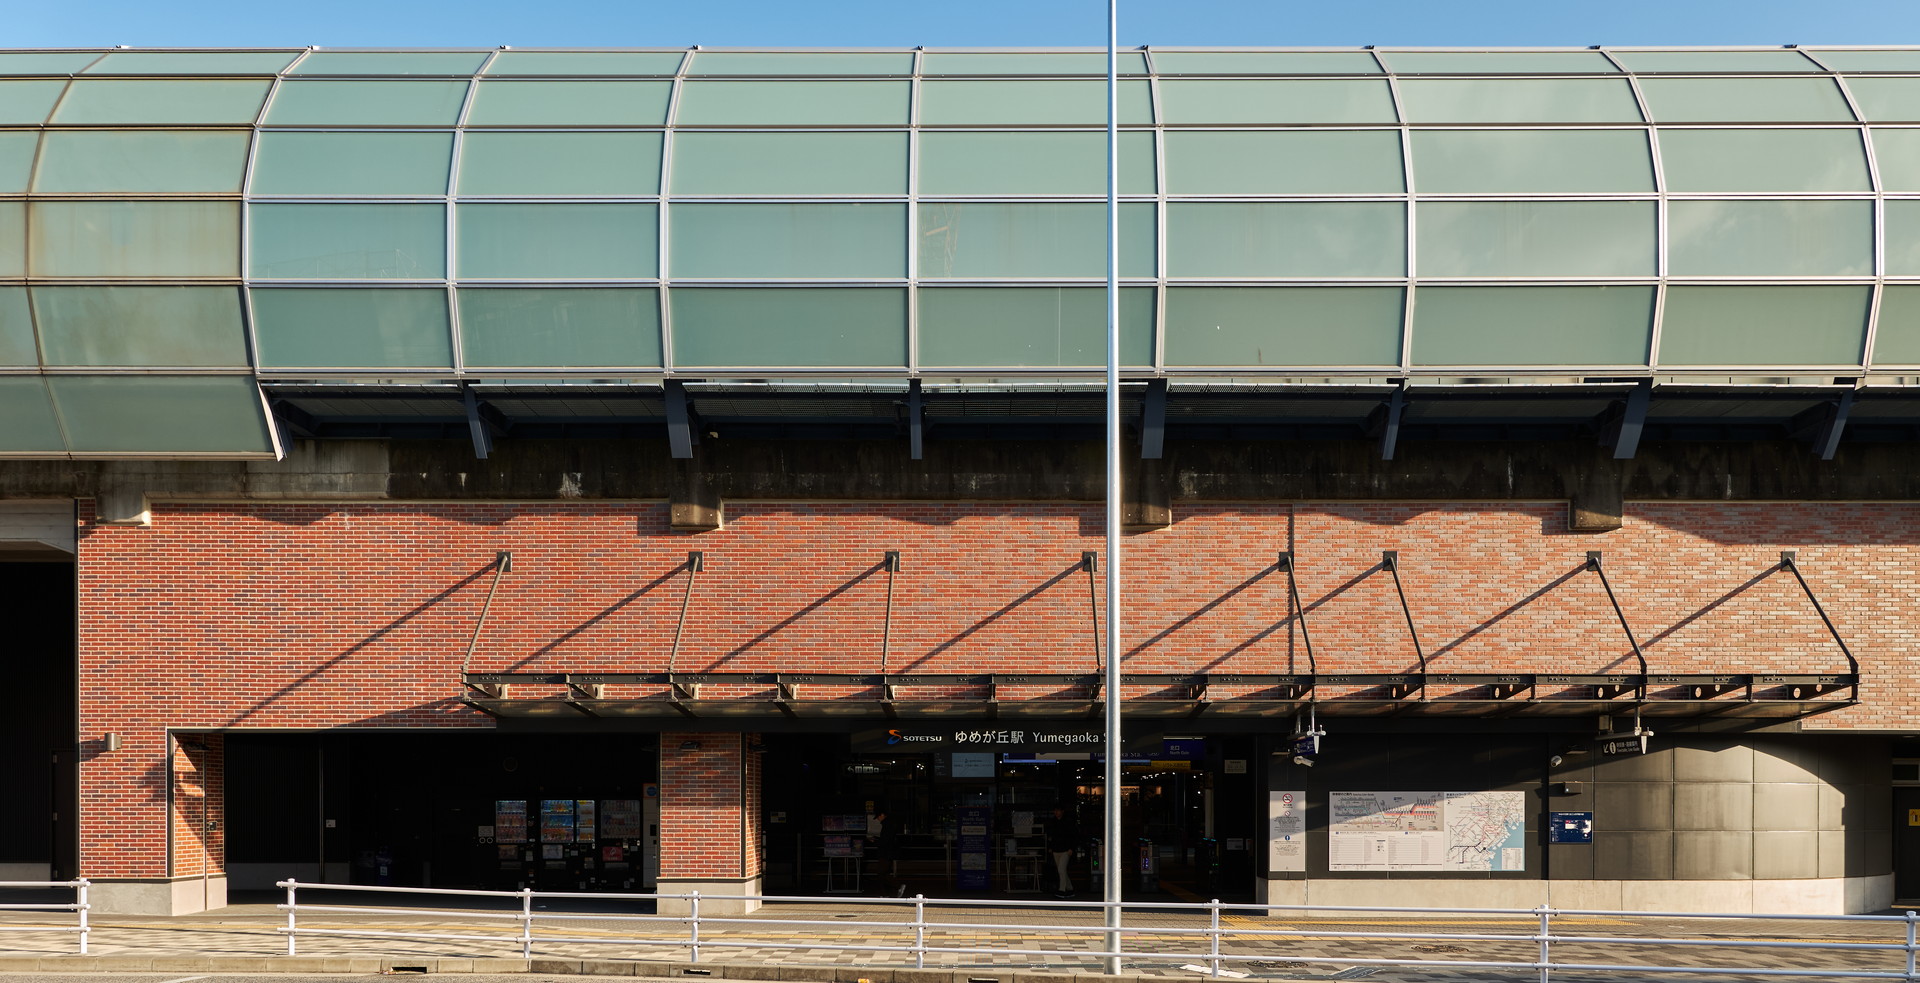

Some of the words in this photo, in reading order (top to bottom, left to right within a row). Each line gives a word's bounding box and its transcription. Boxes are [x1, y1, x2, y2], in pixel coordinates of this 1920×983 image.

[955, 730, 1024, 744] ゆめが丘駅
[1033, 732, 1099, 746] Yumegaoka
